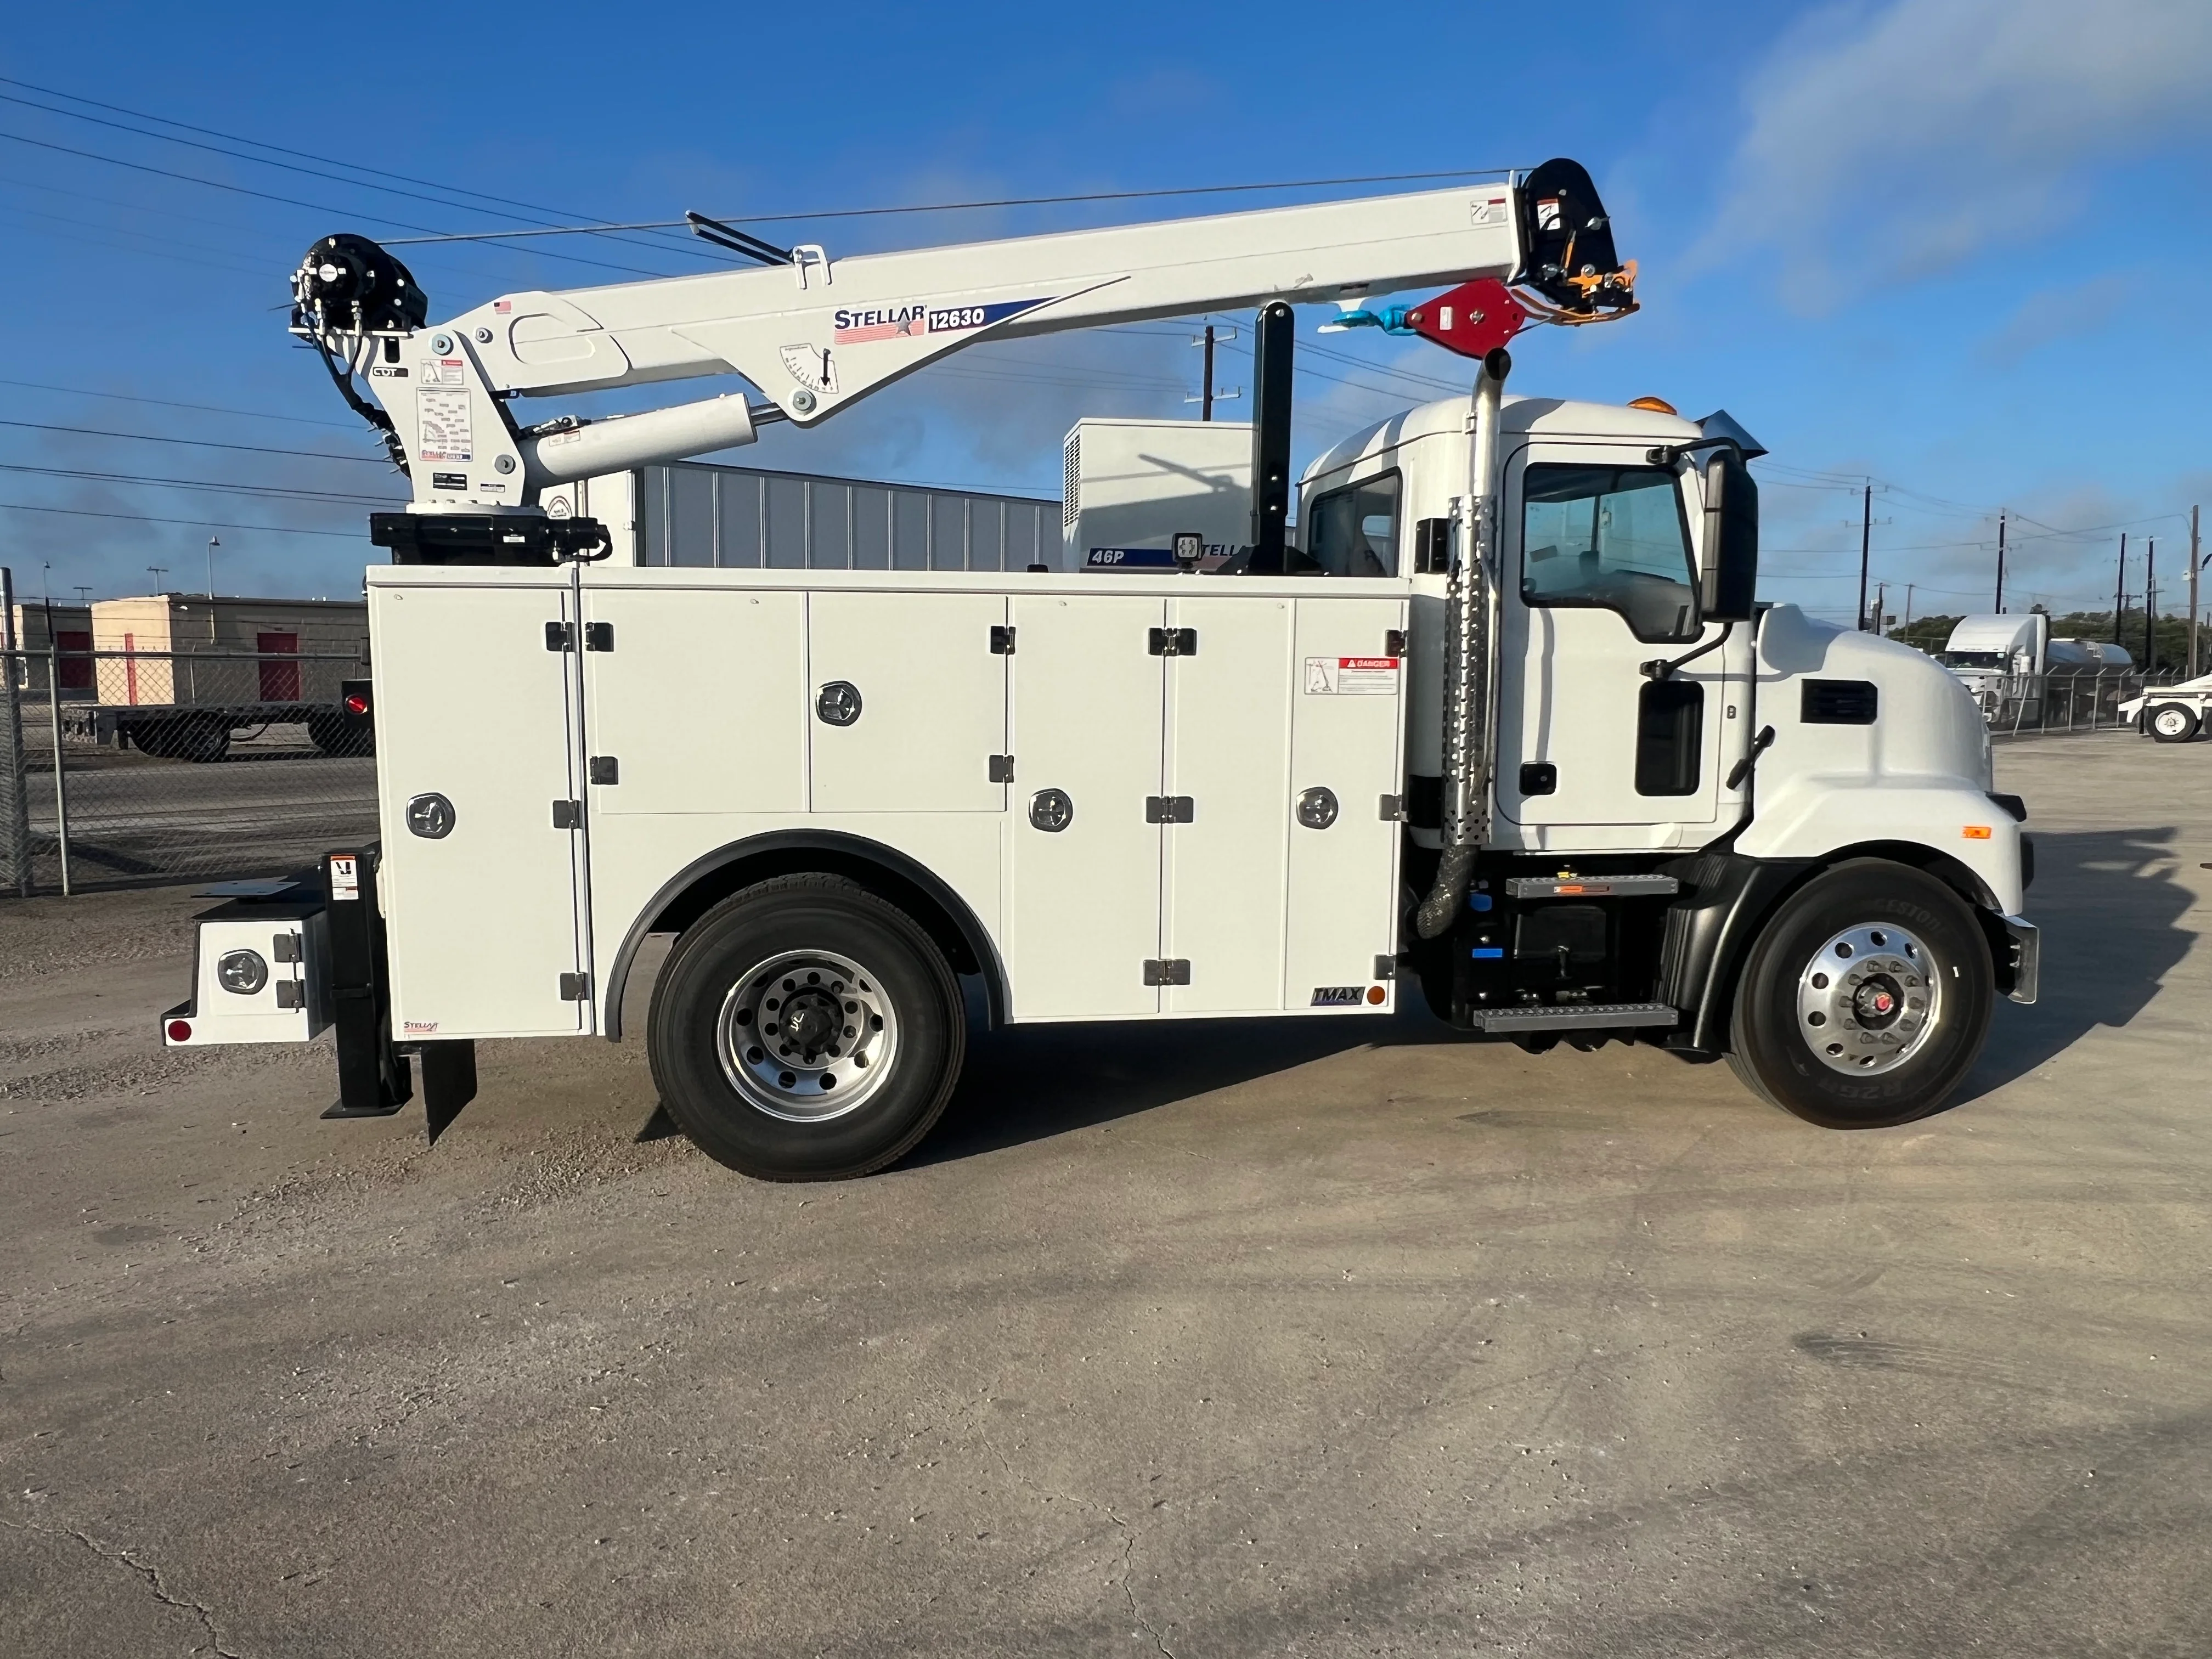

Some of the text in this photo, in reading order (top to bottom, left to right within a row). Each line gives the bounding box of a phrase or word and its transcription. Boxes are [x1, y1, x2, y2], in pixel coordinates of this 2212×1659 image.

[834, 305, 985, 330] STELLAR 12630
[1092, 550, 1124, 564] 46P
[1314, 988, 1361, 1000] TMAX
